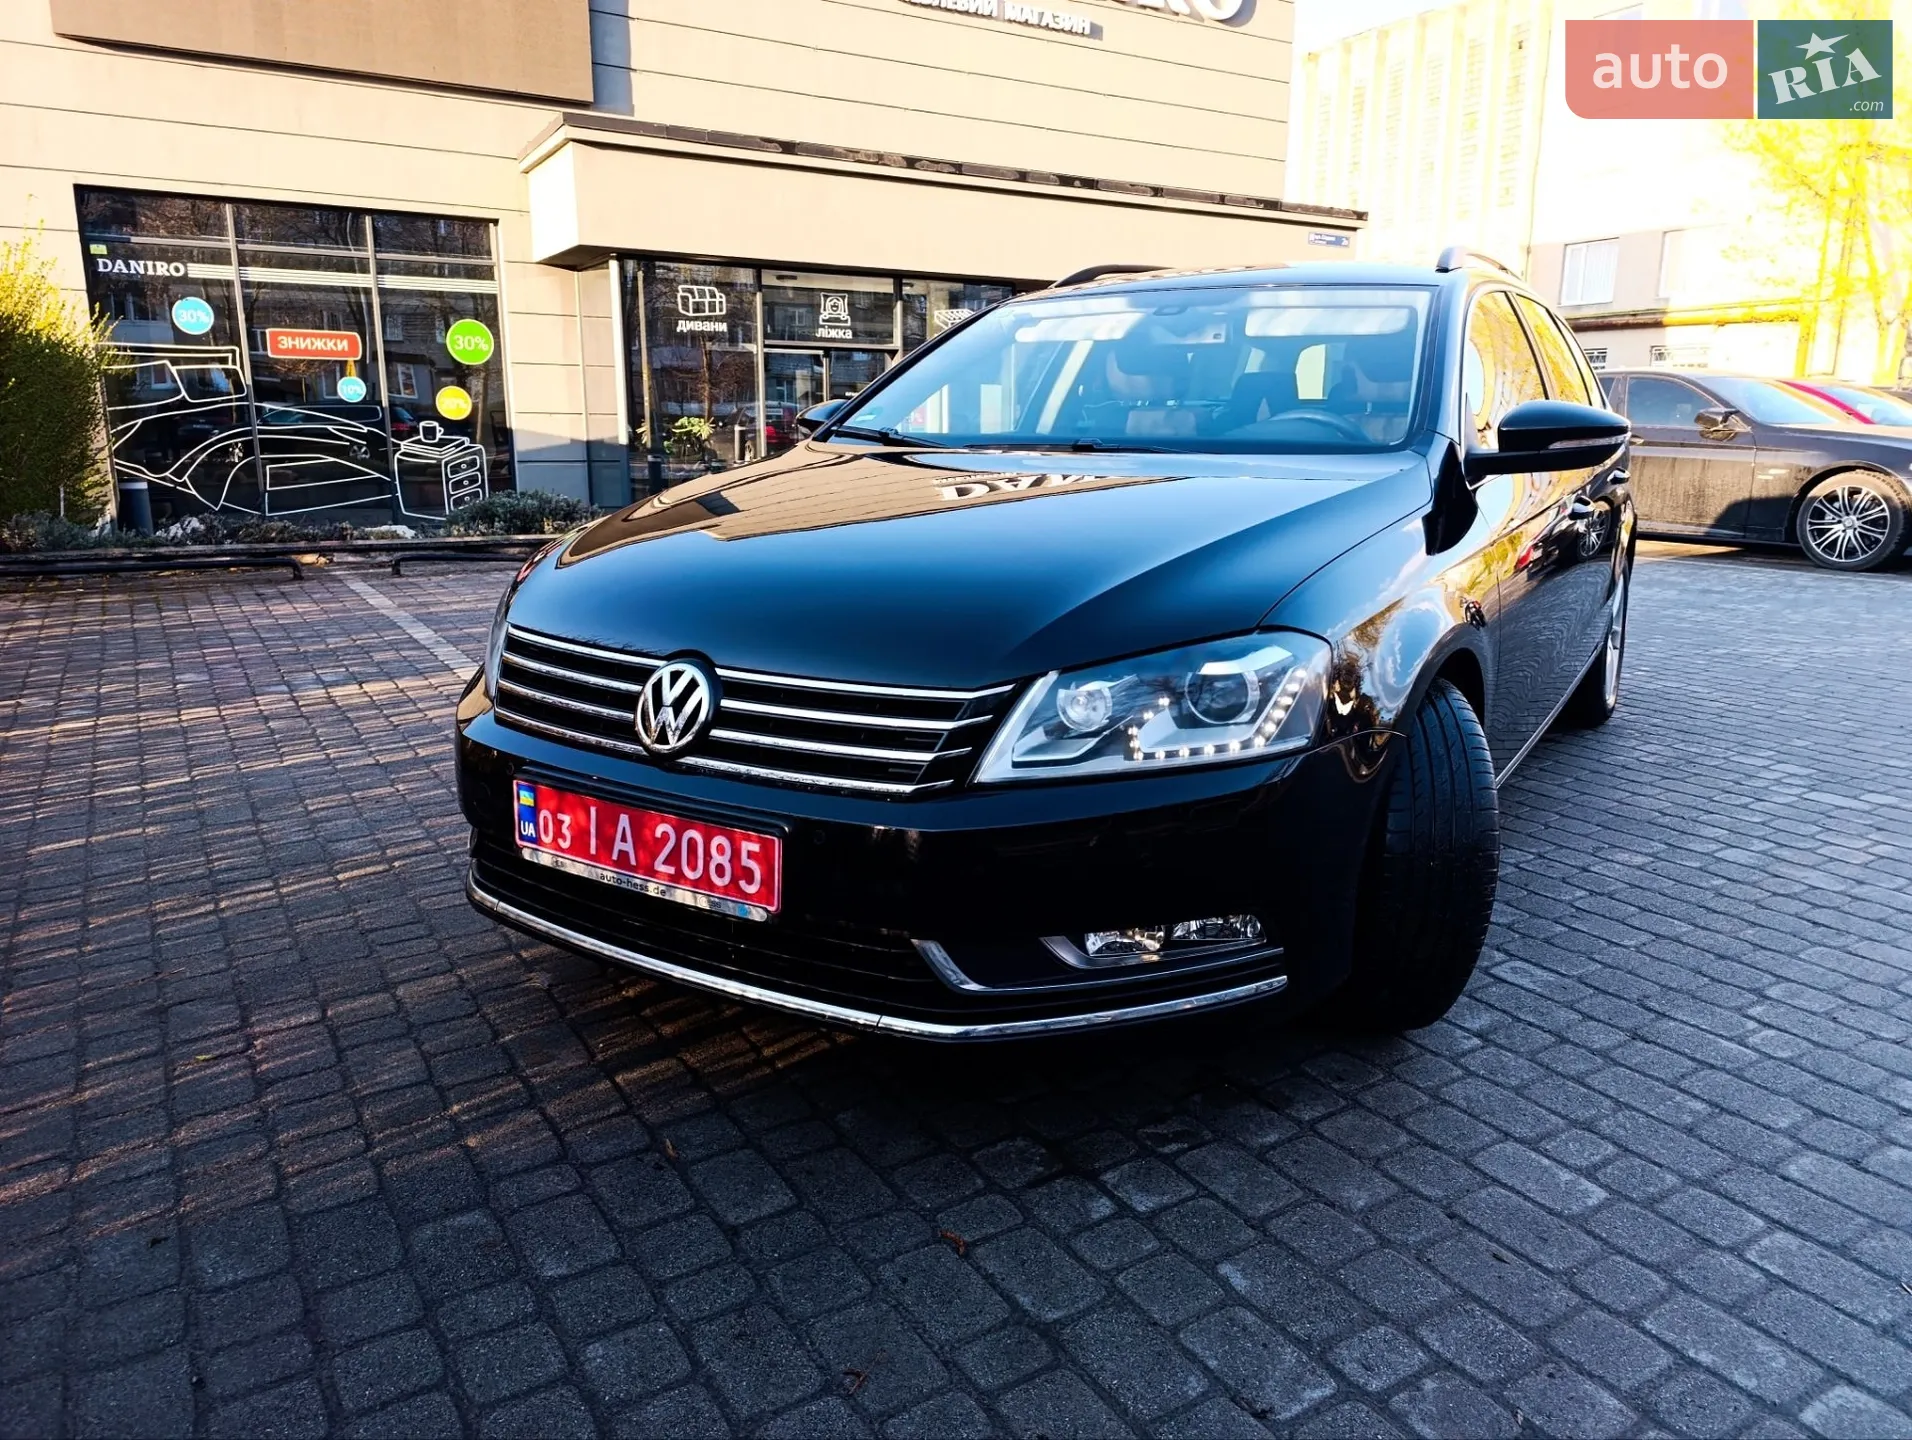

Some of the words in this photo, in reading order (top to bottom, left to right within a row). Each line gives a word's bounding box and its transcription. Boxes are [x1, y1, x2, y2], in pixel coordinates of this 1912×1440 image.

[1003, 2, 1091, 35] МАГАЗИН
[96, 258, 185, 277] DANIRO
[178, 309, 210, 323] 30%
[676, 320, 728, 333] дивани
[815, 325, 853, 339] ліжка
[277, 335, 349, 352] ЗНИЖКИ
[453, 334, 489, 352] 30%
[520, 820, 536, 838] UA
[538, 808, 572, 849] 03
[653, 822, 762, 894] 2085
[599, 872, 667, 897] auto-hess.de
